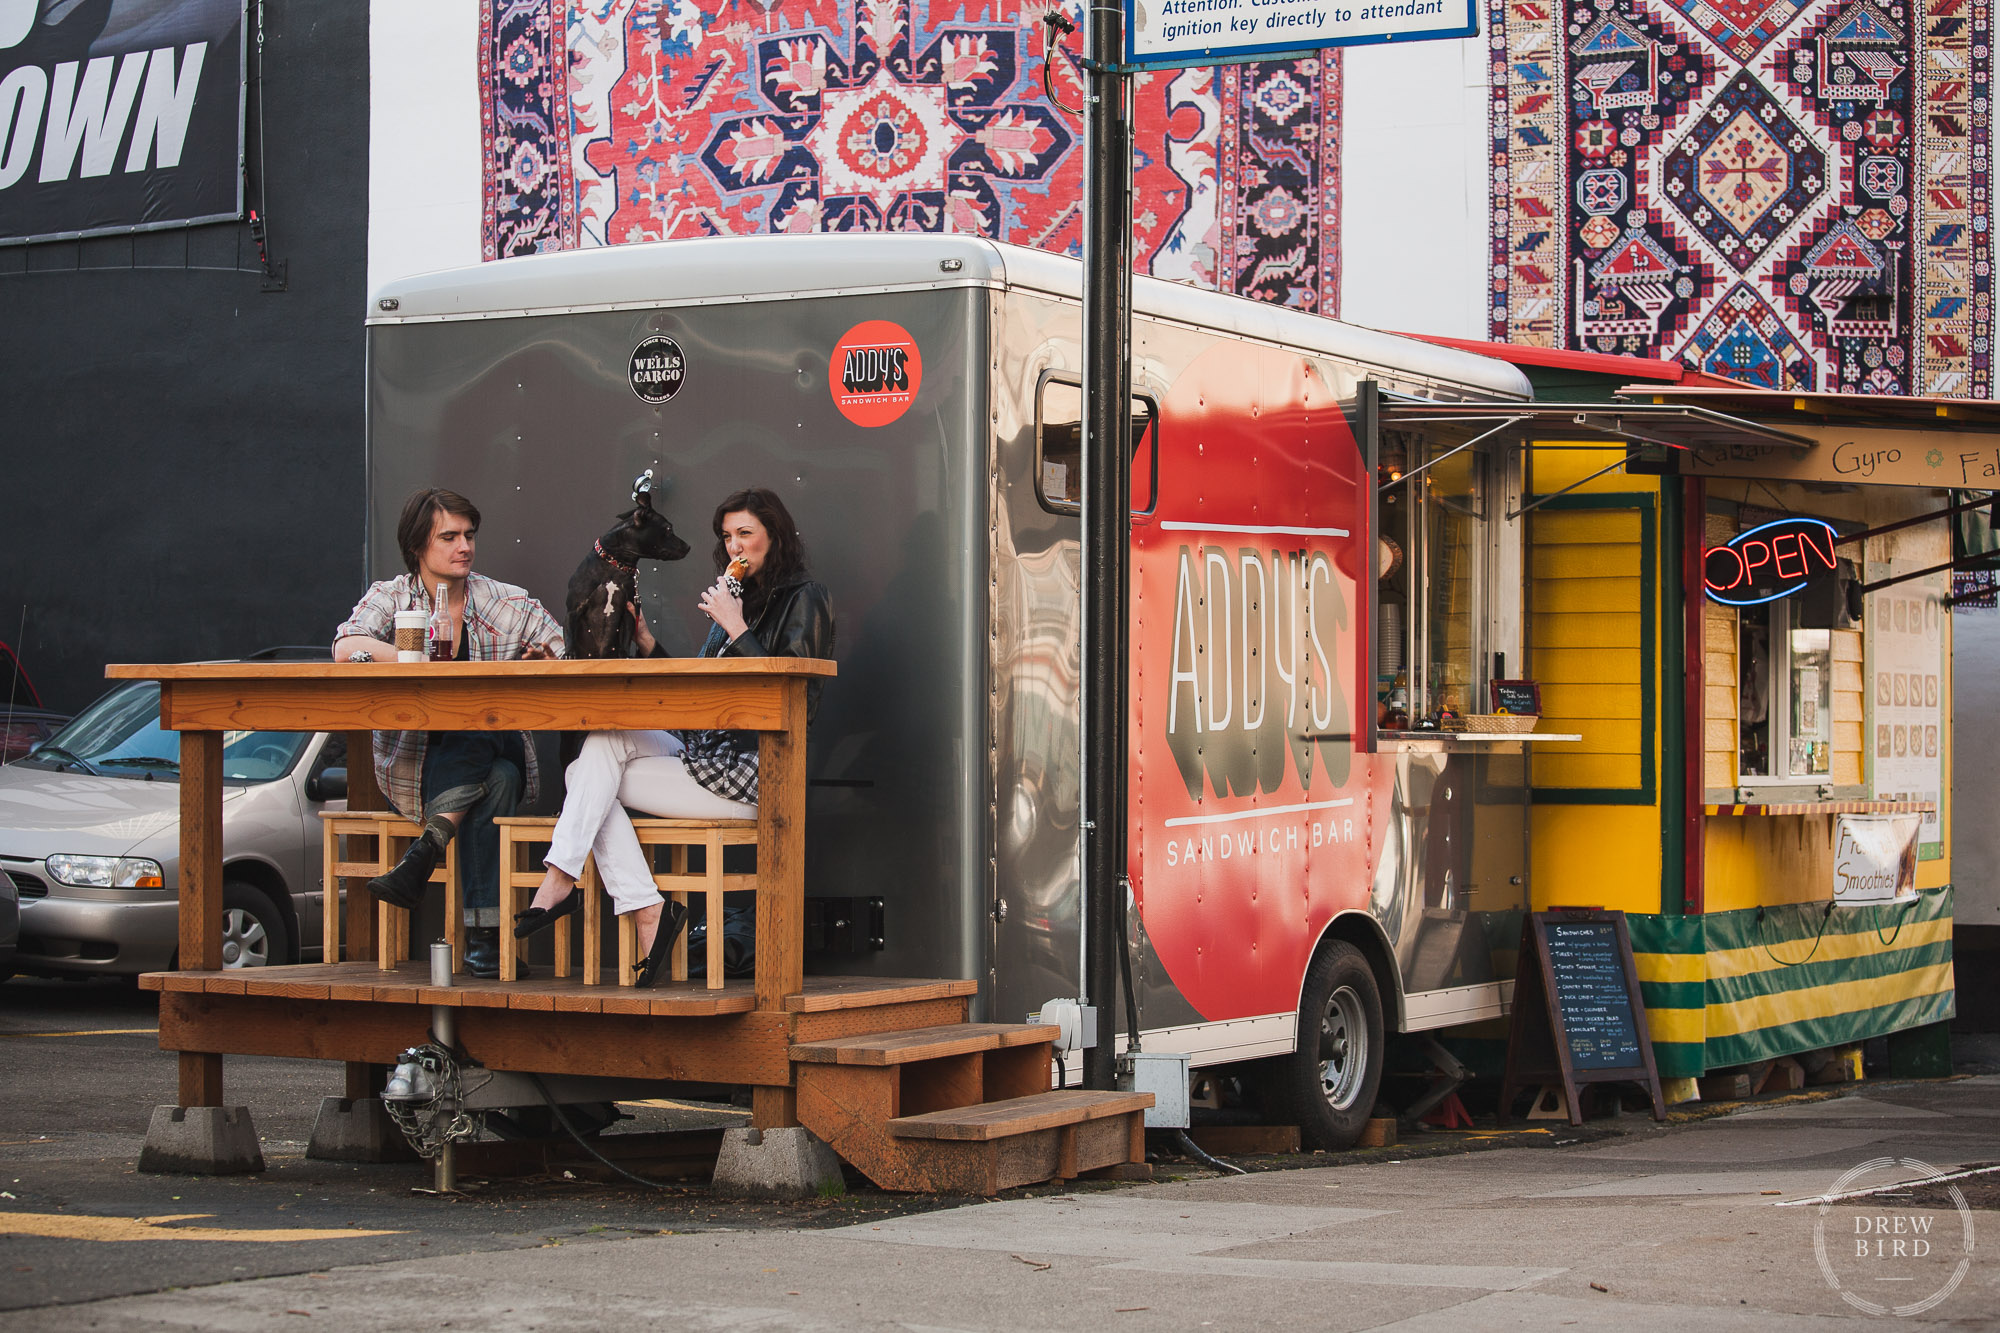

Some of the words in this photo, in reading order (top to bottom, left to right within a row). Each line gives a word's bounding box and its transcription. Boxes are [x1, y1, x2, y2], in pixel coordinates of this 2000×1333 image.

[1162, 19, 1222, 42] ignition
[1230, 16, 1259, 34] key
[1266, 8, 1326, 28] directly
[1335, 8, 1352, 22] to
[1360, 0, 1443, 20] attendant
[643, 338, 659, 348] SINCE
[634, 356, 681, 370] WELLS
[842, 348, 904, 384] ADDY'S
[643, 393, 671, 402] TRAILERS
[841, 397, 888, 405] SANDWICH
[1832, 442, 1902, 477] Gyro
[1705, 525, 1838, 591] OPEN
[1169, 553, 1332, 734] ADDY'S
[1167, 826, 1298, 867] SANDWICH
[1313, 819, 1354, 848] BAR
[1834, 861, 1895, 896] Smoothies
